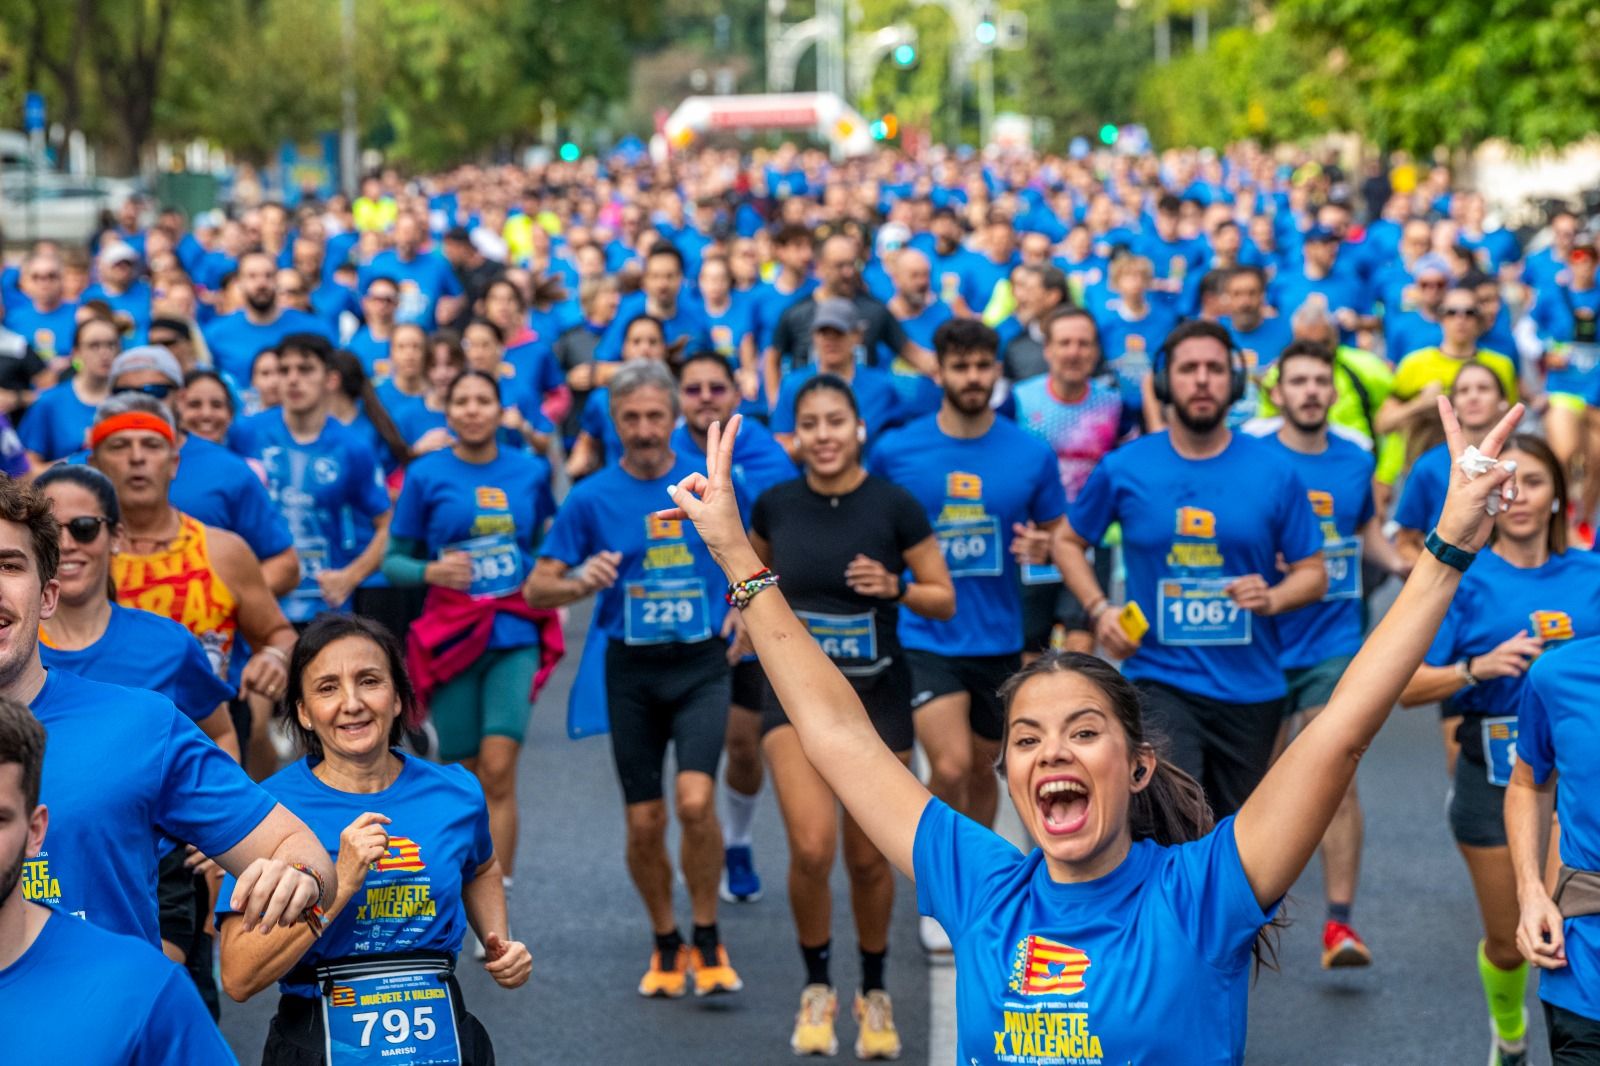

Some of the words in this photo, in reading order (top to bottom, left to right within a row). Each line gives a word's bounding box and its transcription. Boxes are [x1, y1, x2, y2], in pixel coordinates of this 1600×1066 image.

[642, 600, 694, 624] 229
[1168, 600, 1240, 624] 1067
[821, 637, 860, 659] 65
[22, 878, 61, 900] NCIA
[367, 882, 431, 905] MUÉVETE
[356, 905, 367, 920] X
[370, 900, 437, 919] VALENCIA
[360, 991, 403, 1006] MUÉVETE
[404, 990, 411, 1002] X
[411, 988, 447, 1001] VALENCIA
[352, 1006, 436, 1047] 795
[1003, 1008, 1089, 1036] MUÉVETE
[381, 1047, 417, 1057] MARISU
[994, 1031, 1007, 1055] X
[1010, 1033, 1104, 1059] VALENCIA
